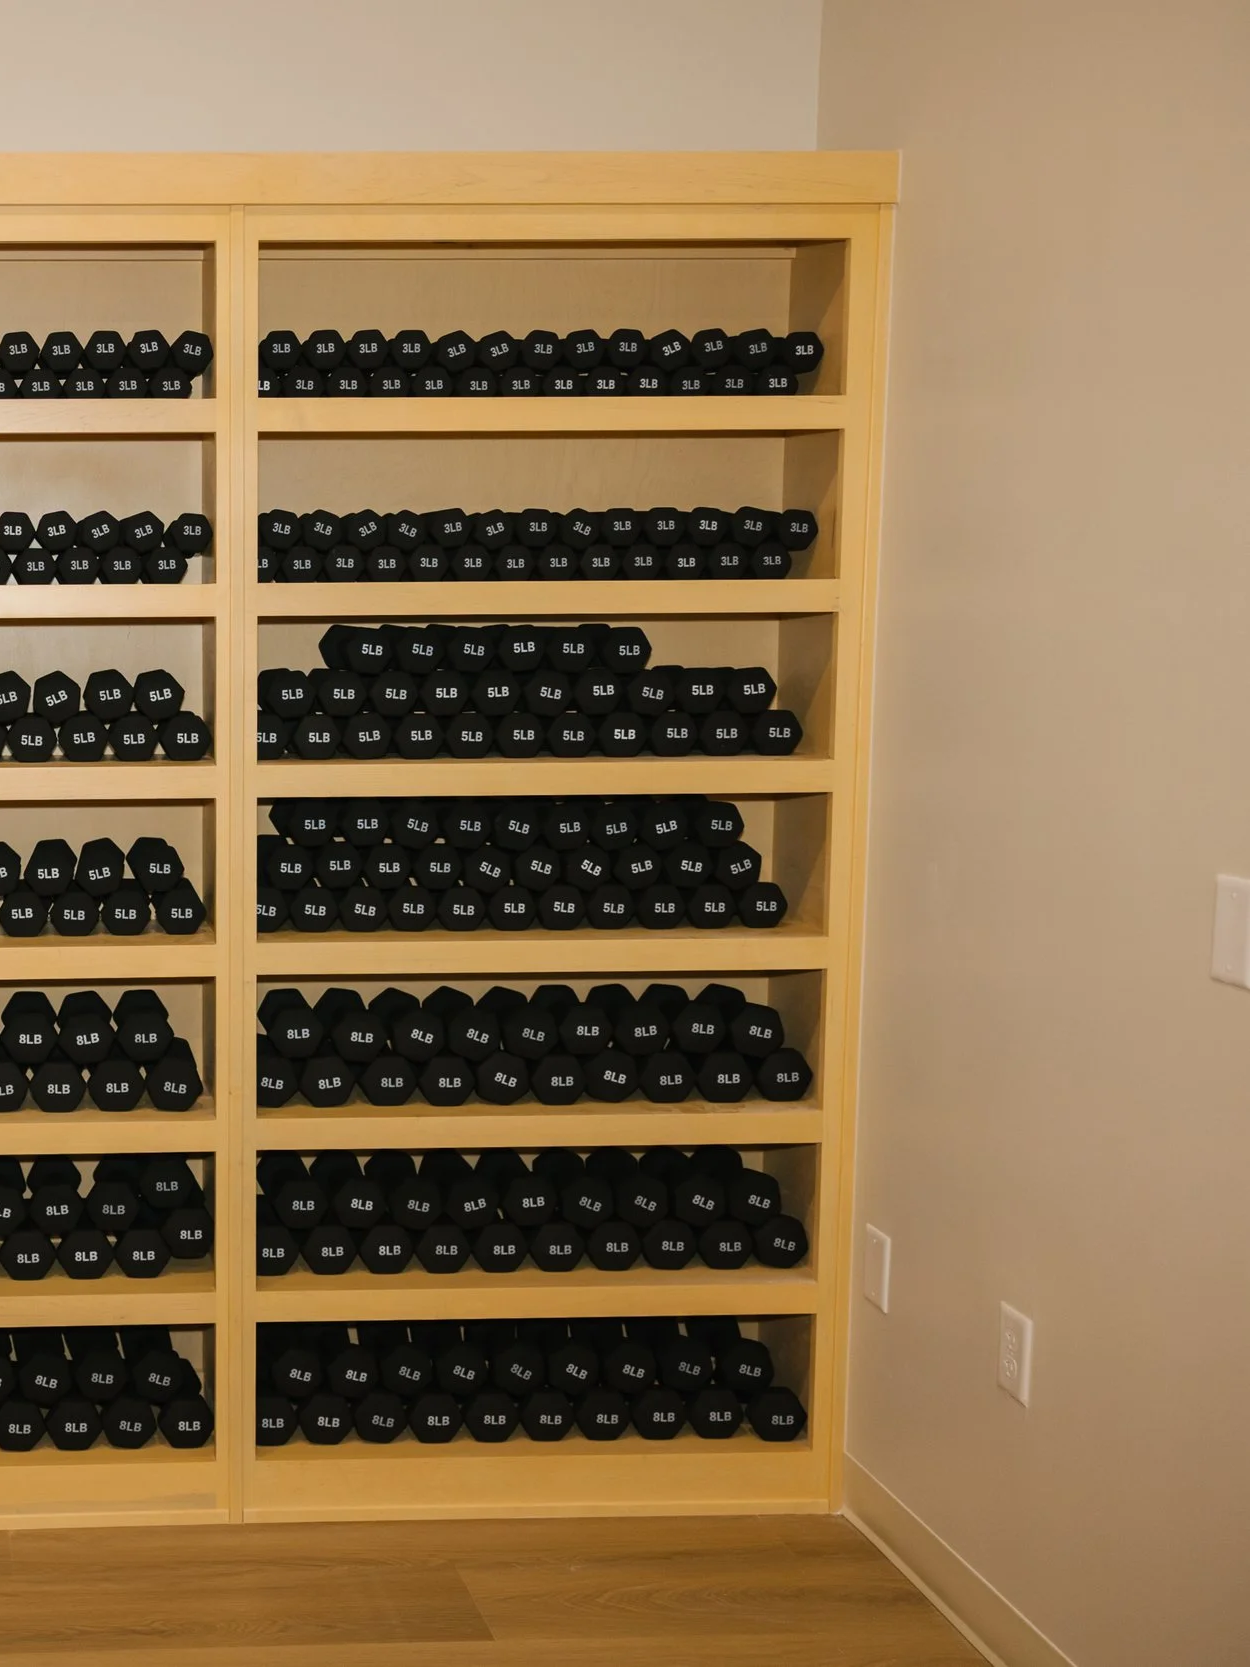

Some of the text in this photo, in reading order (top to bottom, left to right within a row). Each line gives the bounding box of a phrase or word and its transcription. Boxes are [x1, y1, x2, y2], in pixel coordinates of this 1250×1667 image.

[358, 342, 378, 354] 3LB
[446, 343, 467, 358] 3LB
[794, 344, 814, 356] 3LB
[31, 380, 51, 393] 3LB
[75, 380, 95, 392] 3LB
[118, 379, 138, 392] 3LB
[339, 379, 359, 391] 3LB
[424, 379, 444, 391] 3LB
[596, 378, 616, 390] 3LB
[639, 377, 659, 389] 3LB
[46, 524, 67, 538] 3LB
[90, 523, 111, 539] 3LB
[272, 522, 292, 535] 3LB
[572, 521, 592, 536] 3LB
[698, 519, 718, 531] 3LB
[70, 559, 90, 571] 3LB
[335, 557, 355, 569] 3LB
[419, 557, 439, 568] 3LB
[463, 557, 483, 569] 3LB
[677, 557, 696, 568] 3LB
[361, 643, 384, 657] 5LB
[148, 687, 173, 703] 5LB
[435, 687, 458, 699] 5LB
[487, 685, 510, 699] 5LB
[592, 684, 615, 697] 5LB
[691, 684, 715, 696] 5LB
[45, 689, 69, 707] 5LB
[176, 732, 200, 744] 5LB
[308, 731, 331, 744] 5LB
[613, 728, 637, 741] 5LB
[279, 862, 303, 874] 5LB
[378, 861, 401, 874] 5LB
[580, 858, 603, 877] 5LB
[680, 859, 703, 873] 5LB
[37, 867, 60, 880] 5LB
[88, 866, 112, 881] 5LB
[10, 907, 34, 920] 5LB
[353, 903, 377, 917] 5LB
[452, 903, 475, 916] 5LB
[503, 902, 526, 914] 5LB
[552, 900, 576, 914] 5LB
[349, 1031, 374, 1044] 8LB
[410, 1028, 434, 1045] 8LB
[576, 1025, 600, 1037] 8LB
[18, 1033, 43, 1045] 8LB
[75, 1032, 100, 1046] 8LB
[317, 1076, 342, 1090] 8LB
[493, 1071, 518, 1088] 8LB
[603, 1069, 627, 1085] 8LB
[716, 1073, 741, 1085] 8LB
[46, 1083, 71, 1095] 8LB
[350, 1197, 374, 1211] 8LB
[463, 1197, 487, 1213] 8LB
[522, 1196, 546, 1209] 8LB
[691, 1194, 715, 1211] 8LB
[74, 1250, 99, 1262] 8LB
[132, 1250, 156, 1262] 8LB
[261, 1247, 286, 1259] 8LB
[493, 1244, 517, 1256] 8LB
[548, 1244, 573, 1256] 8LB
[345, 1369, 368, 1383] 8LB
[565, 1363, 588, 1380] 8LB
[316, 1415, 341, 1428] 8LB
[426, 1415, 451, 1427] 8LB
[483, 1414, 507, 1425] 8LB
[596, 1413, 619, 1425] 8LB
[652, 1411, 676, 1423] 8LB
[64, 1422, 88, 1433] 8LB
[177, 1420, 201, 1432] 8LB
